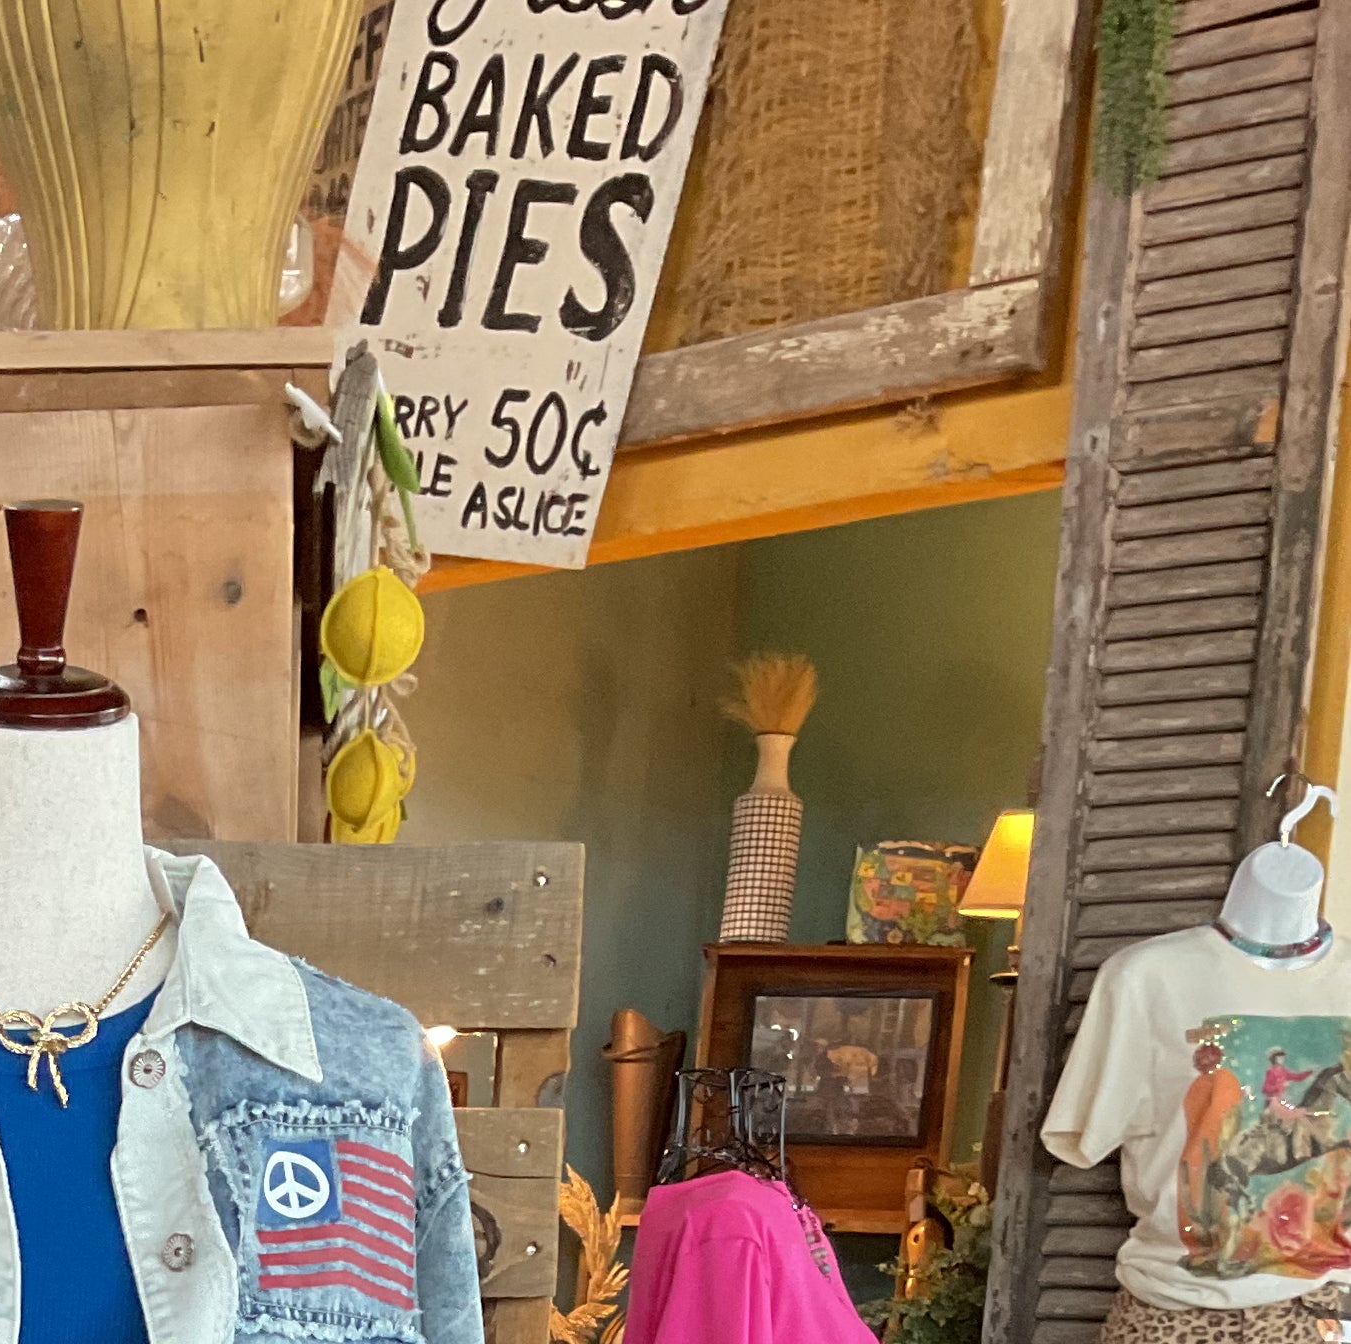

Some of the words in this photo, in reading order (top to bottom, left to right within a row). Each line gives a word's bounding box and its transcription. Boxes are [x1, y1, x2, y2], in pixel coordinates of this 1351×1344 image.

[399, 50, 684, 162] BAKED
[360, 165, 654, 341] PIES
[392, 394, 468, 439] RRY
[484, 388, 608, 480] 50¢
